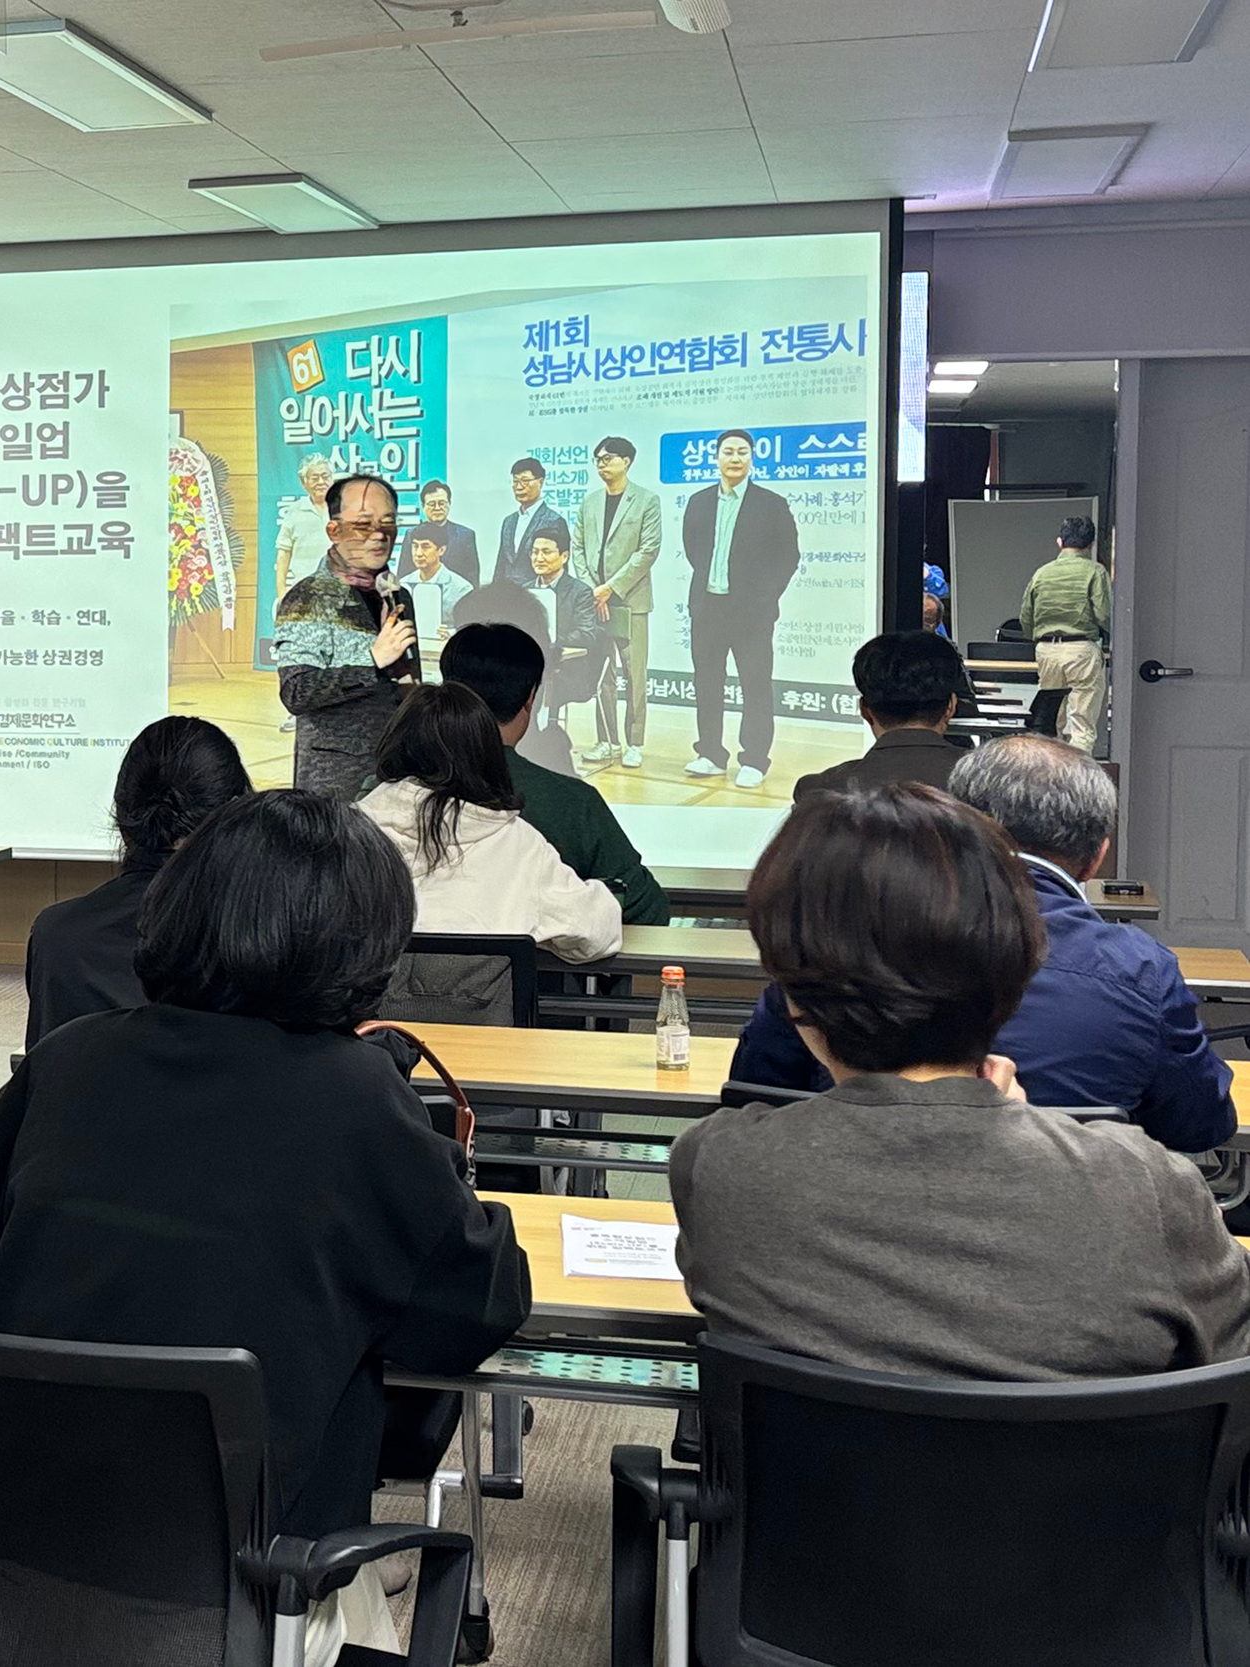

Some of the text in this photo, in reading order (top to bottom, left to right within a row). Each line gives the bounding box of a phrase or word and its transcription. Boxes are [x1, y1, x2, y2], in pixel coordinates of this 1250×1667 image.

[523, 314, 590, 352] 제1회
[291, 349, 320, 385] 61
[346, 329, 422, 387] 다시
[523, 331, 748, 388] 성남시상인연합회
[280, 388, 424, 445] 일어서는
[774, 464, 810, 479] 상인이
[31, 609, 62, 626] 학습
[76, 609, 111, 627] 연대,
[42, 649, 105, 667] 상권경영
[781, 690, 826, 712] 후원:
[0, 737, 46, 747] ECONOMIC
[47, 737, 89, 747] CULTURE
[90, 738, 131, 748] INSTITUT
